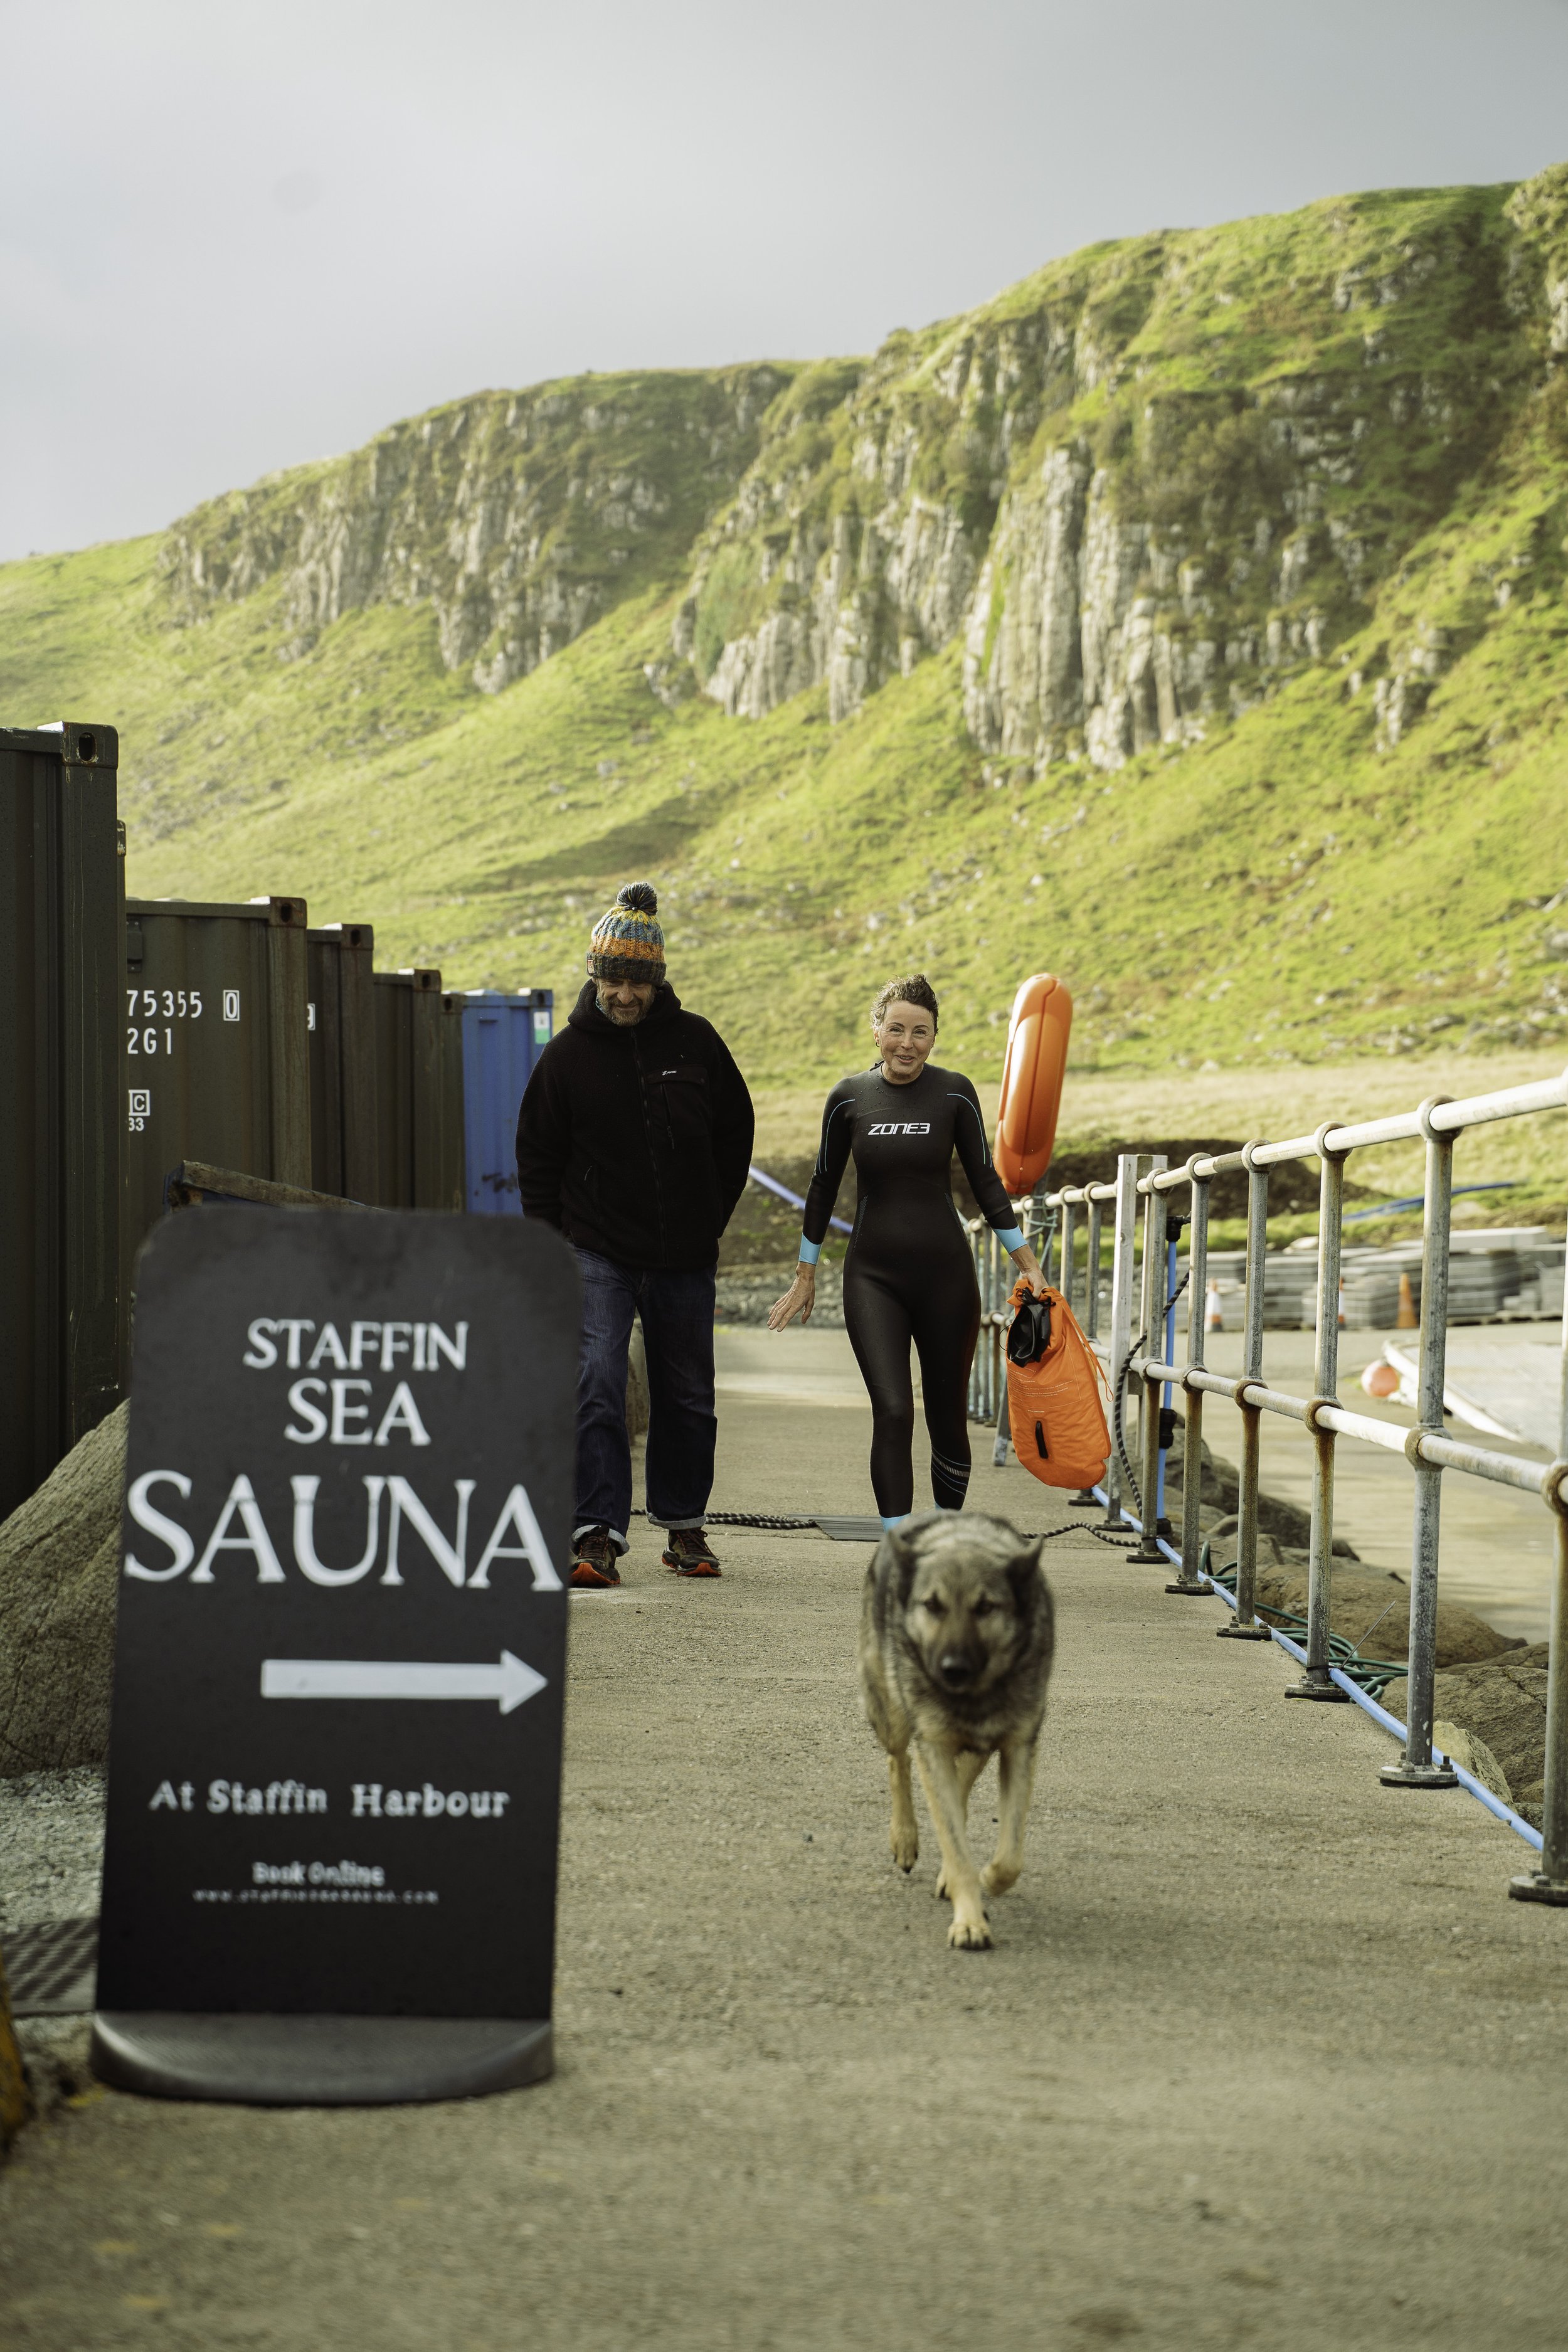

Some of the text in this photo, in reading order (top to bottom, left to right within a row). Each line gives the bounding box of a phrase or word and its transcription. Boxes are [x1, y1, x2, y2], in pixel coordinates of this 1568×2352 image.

[226, 992, 238, 1019] 0
[868, 1123, 931, 1135] ZONE3
[243, 1317, 470, 1372] STAFFIN
[284, 1377, 432, 1446] SEA
[124, 1470, 563, 1591] SAUNA
[149, 1779, 511, 1818] At Staffin Harbour
[252, 1860, 385, 1887] Book Online
